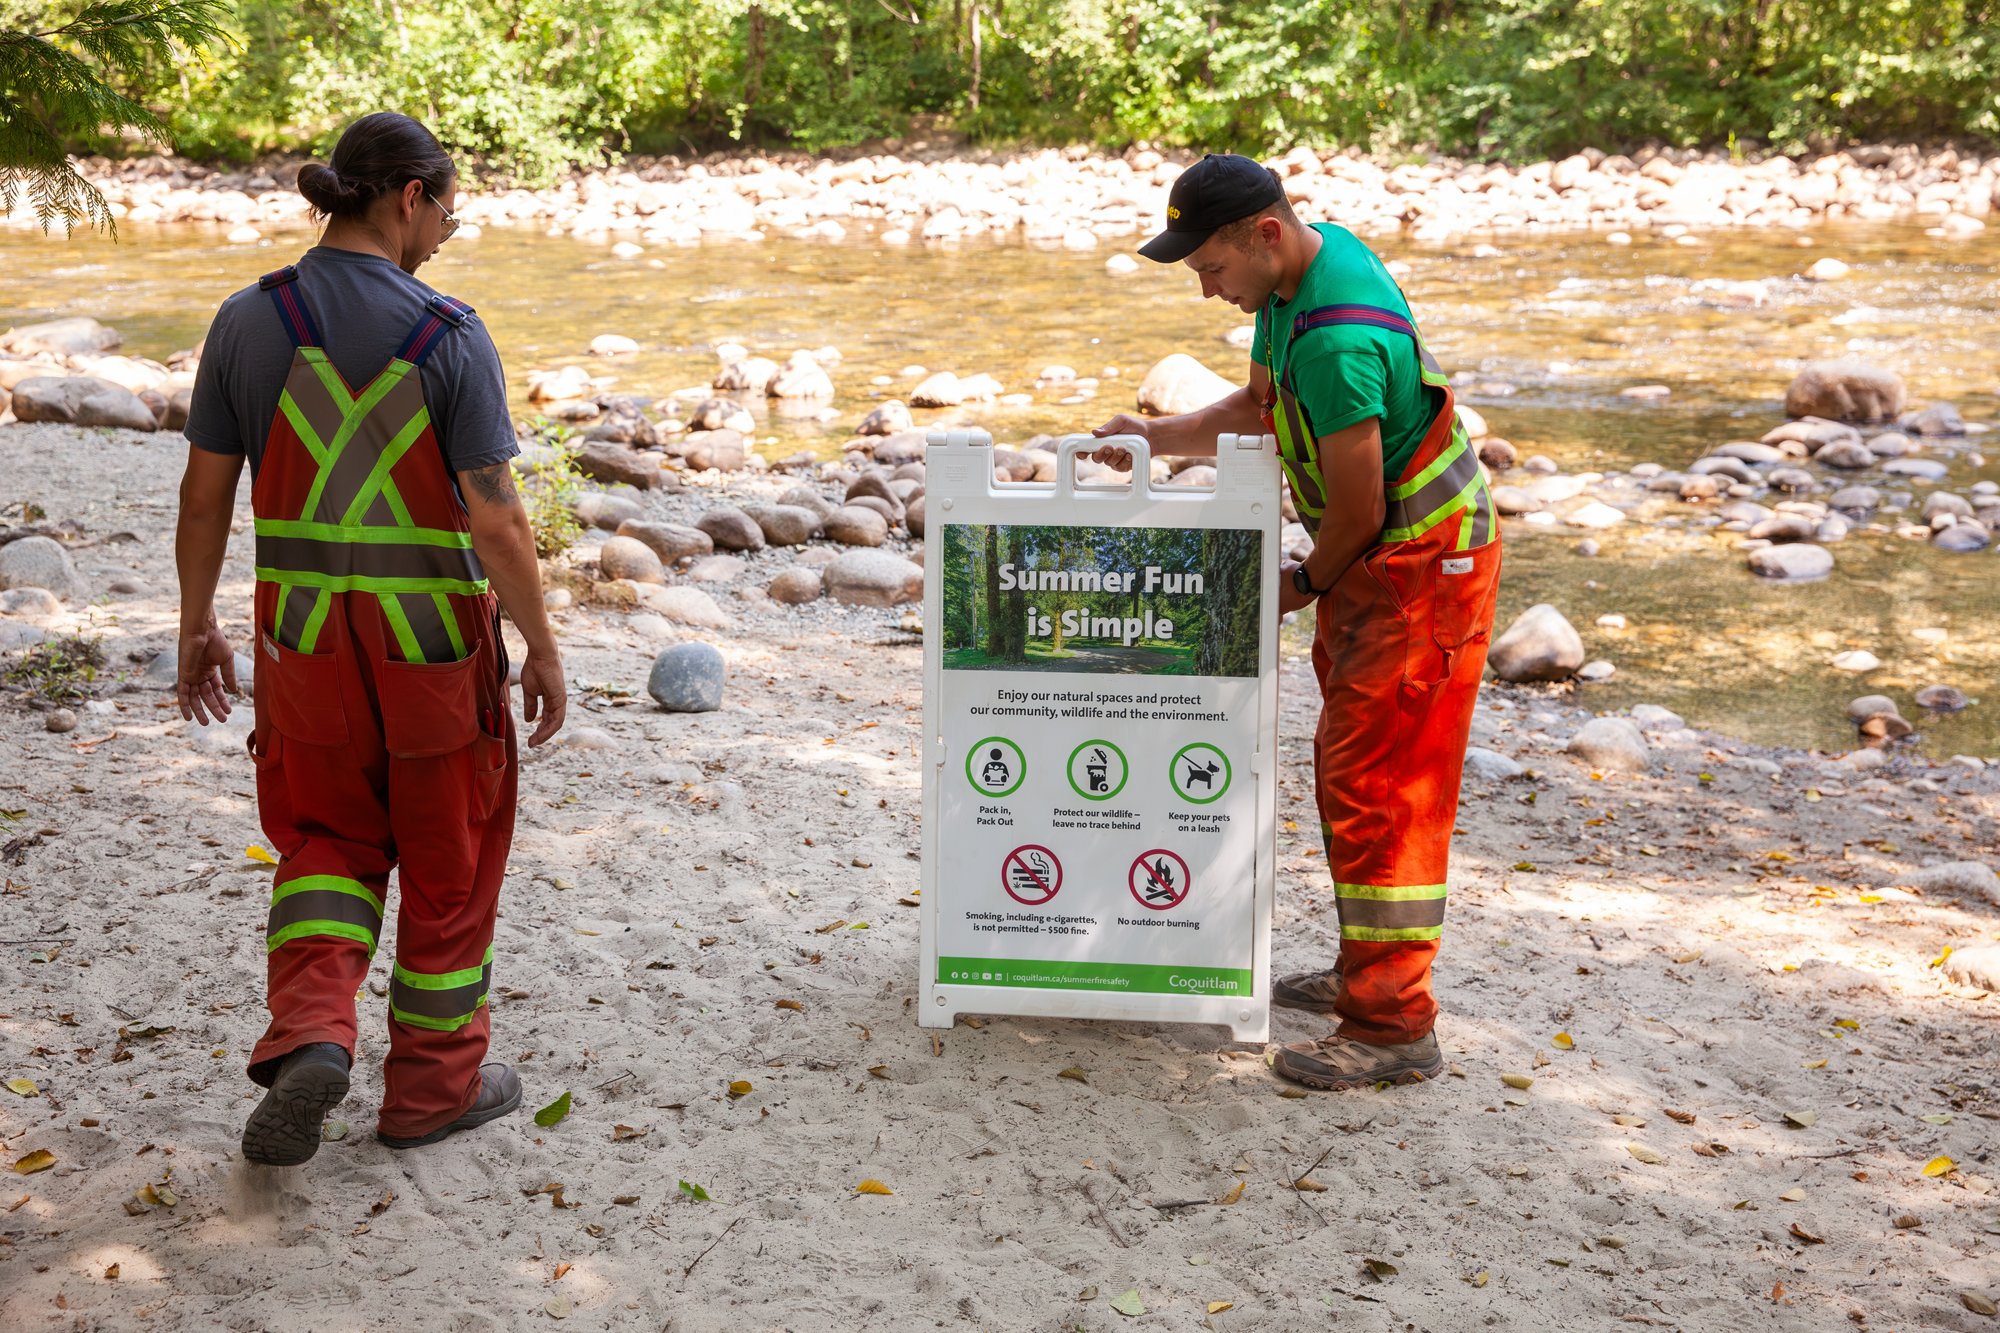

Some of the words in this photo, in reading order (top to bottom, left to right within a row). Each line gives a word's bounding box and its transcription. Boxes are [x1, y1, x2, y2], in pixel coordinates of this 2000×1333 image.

[998, 563, 1136, 593] Summer
[1145, 567, 1204, 594] Fun
[1028, 607, 1052, 636] is
[1061, 608, 1173, 646] Simple
[998, 689, 1029, 703] Enjoy
[1031, 692, 1050, 701] our
[1053, 691, 1093, 702] natural
[1096, 694, 1133, 706] spaces
[1136, 692, 1157, 703] and
[1160, 694, 1202, 707] protect
[970, 706, 989, 715] our
[992, 705, 1058, 719] community,
[1061, 706, 1103, 718] wildlife
[1105, 707, 1127, 719] and
[1130, 708, 1149, 719] the
[1152, 710, 1228, 722] environment.
[979, 805, 998, 815] Pack
[1001, 805, 1011, 816] in,
[1053, 808, 1085, 818] Protect
[1086, 810, 1100, 818] our
[1102, 809, 1132, 819] wildlife
[977, 816, 996, 826] Pack
[998, 817, 1013, 826] Out
[1168, 811, 1190, 823] Keep
[1191, 814, 1210, 824] your
[1212, 814, 1231, 824] pets
[1052, 819, 1074, 829] leave
[1076, 821, 1087, 829] no
[1089, 821, 1110, 830] trace
[1111, 820, 1141, 831] behind
[1198, 823, 1220, 833] leash
[965, 911, 1004, 923] Smoking,
[1006, 912, 1044, 924] including
[1046, 914, 1098, 927] e-cigarettes,
[1118, 917, 1129, 926] No
[1130, 918, 1165, 928] outdoor
[1167, 918, 1200, 930] burning
[973, 923, 980, 931] is
[982, 924, 997, 933] not
[998, 924, 1039, 935] permitted
[1048, 924, 1069, 935] $500
[1071, 925, 1090, 935] fine.
[1012, 973, 1130, 987] coquitlam.ca/summerfiresafety
